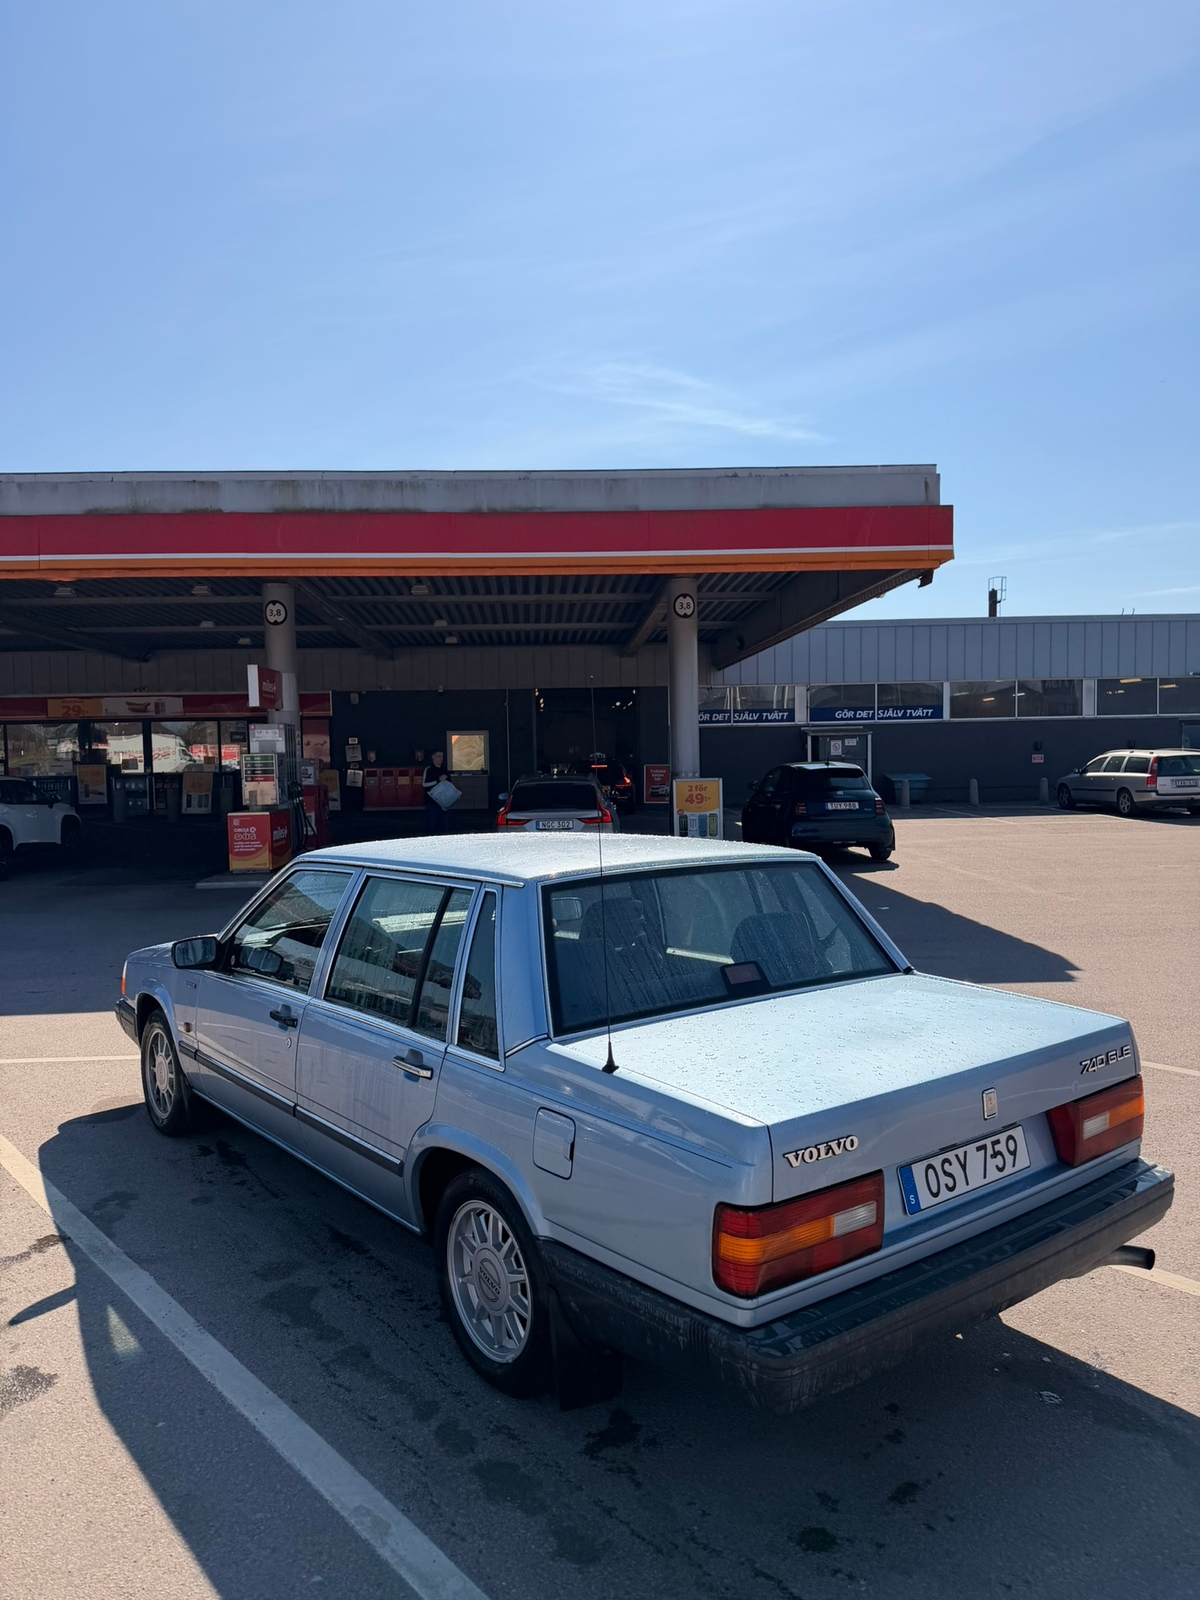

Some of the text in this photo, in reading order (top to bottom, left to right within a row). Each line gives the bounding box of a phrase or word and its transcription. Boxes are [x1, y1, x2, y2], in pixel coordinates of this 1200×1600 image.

[679, 602, 691, 610] 3,8
[268, 608, 282, 617] 3,8
[712, 713, 730, 721] DET
[733, 711, 760, 721] SJÄLV
[762, 710, 789, 721] TVÄTT
[835, 707, 933, 719] GÖR DET SJÄLV TVÄTT
[694, 784, 708, 792] för
[685, 793, 711, 804] 49:-
[541, 821, 555, 829] NGC
[233, 832, 257, 841] extra
[1080, 1045, 1131, 1075] 740 GLE
[785, 1135, 859, 1168] VOLVO
[924, 1134, 1018, 1199] OSY 759
[909, 1194, 916, 1205] S
[478, 1265, 501, 1295] VOLVO
